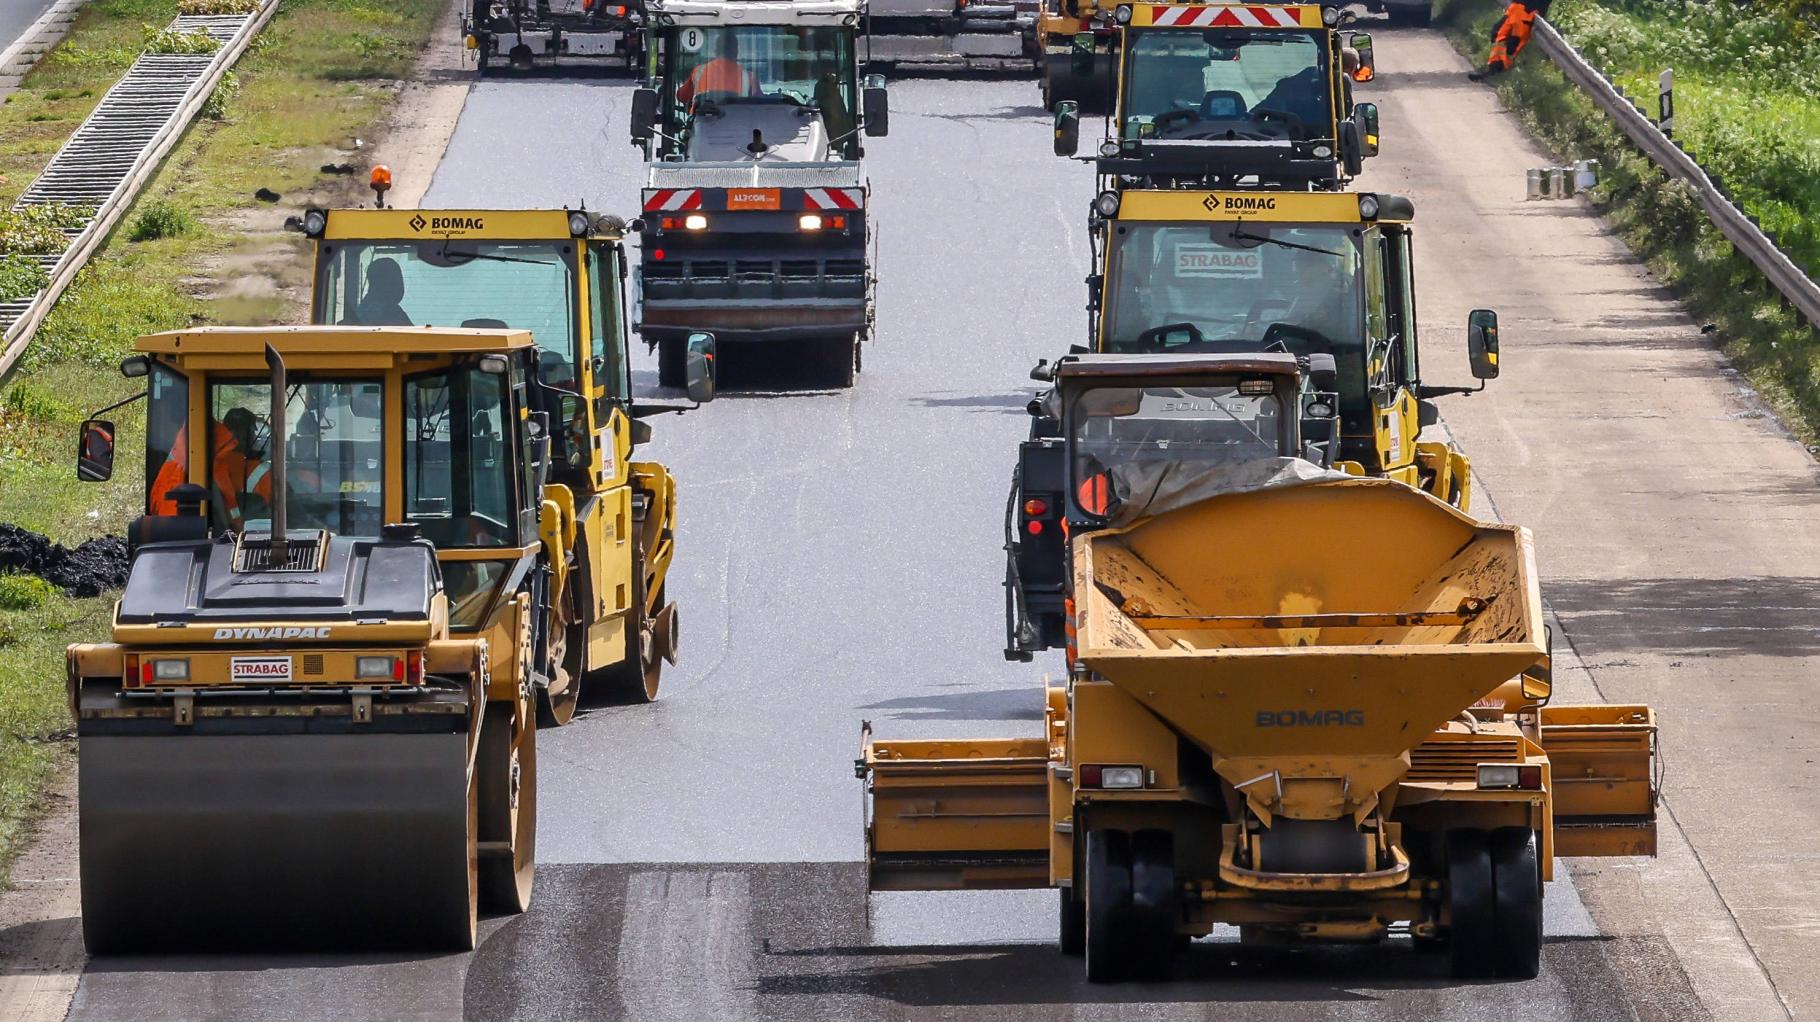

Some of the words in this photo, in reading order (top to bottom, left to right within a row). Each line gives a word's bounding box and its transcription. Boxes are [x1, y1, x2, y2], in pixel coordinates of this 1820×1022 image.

[688, 30, 697, 47] 8
[1224, 197, 1276, 210] BOMAG
[431, 217, 484, 230] BOMAG
[1179, 253, 1259, 268] STRABAG
[213, 626, 332, 640] DYNAPAC
[233, 664, 289, 675] STRABAG
[1255, 709, 1366, 728] BOMAG
